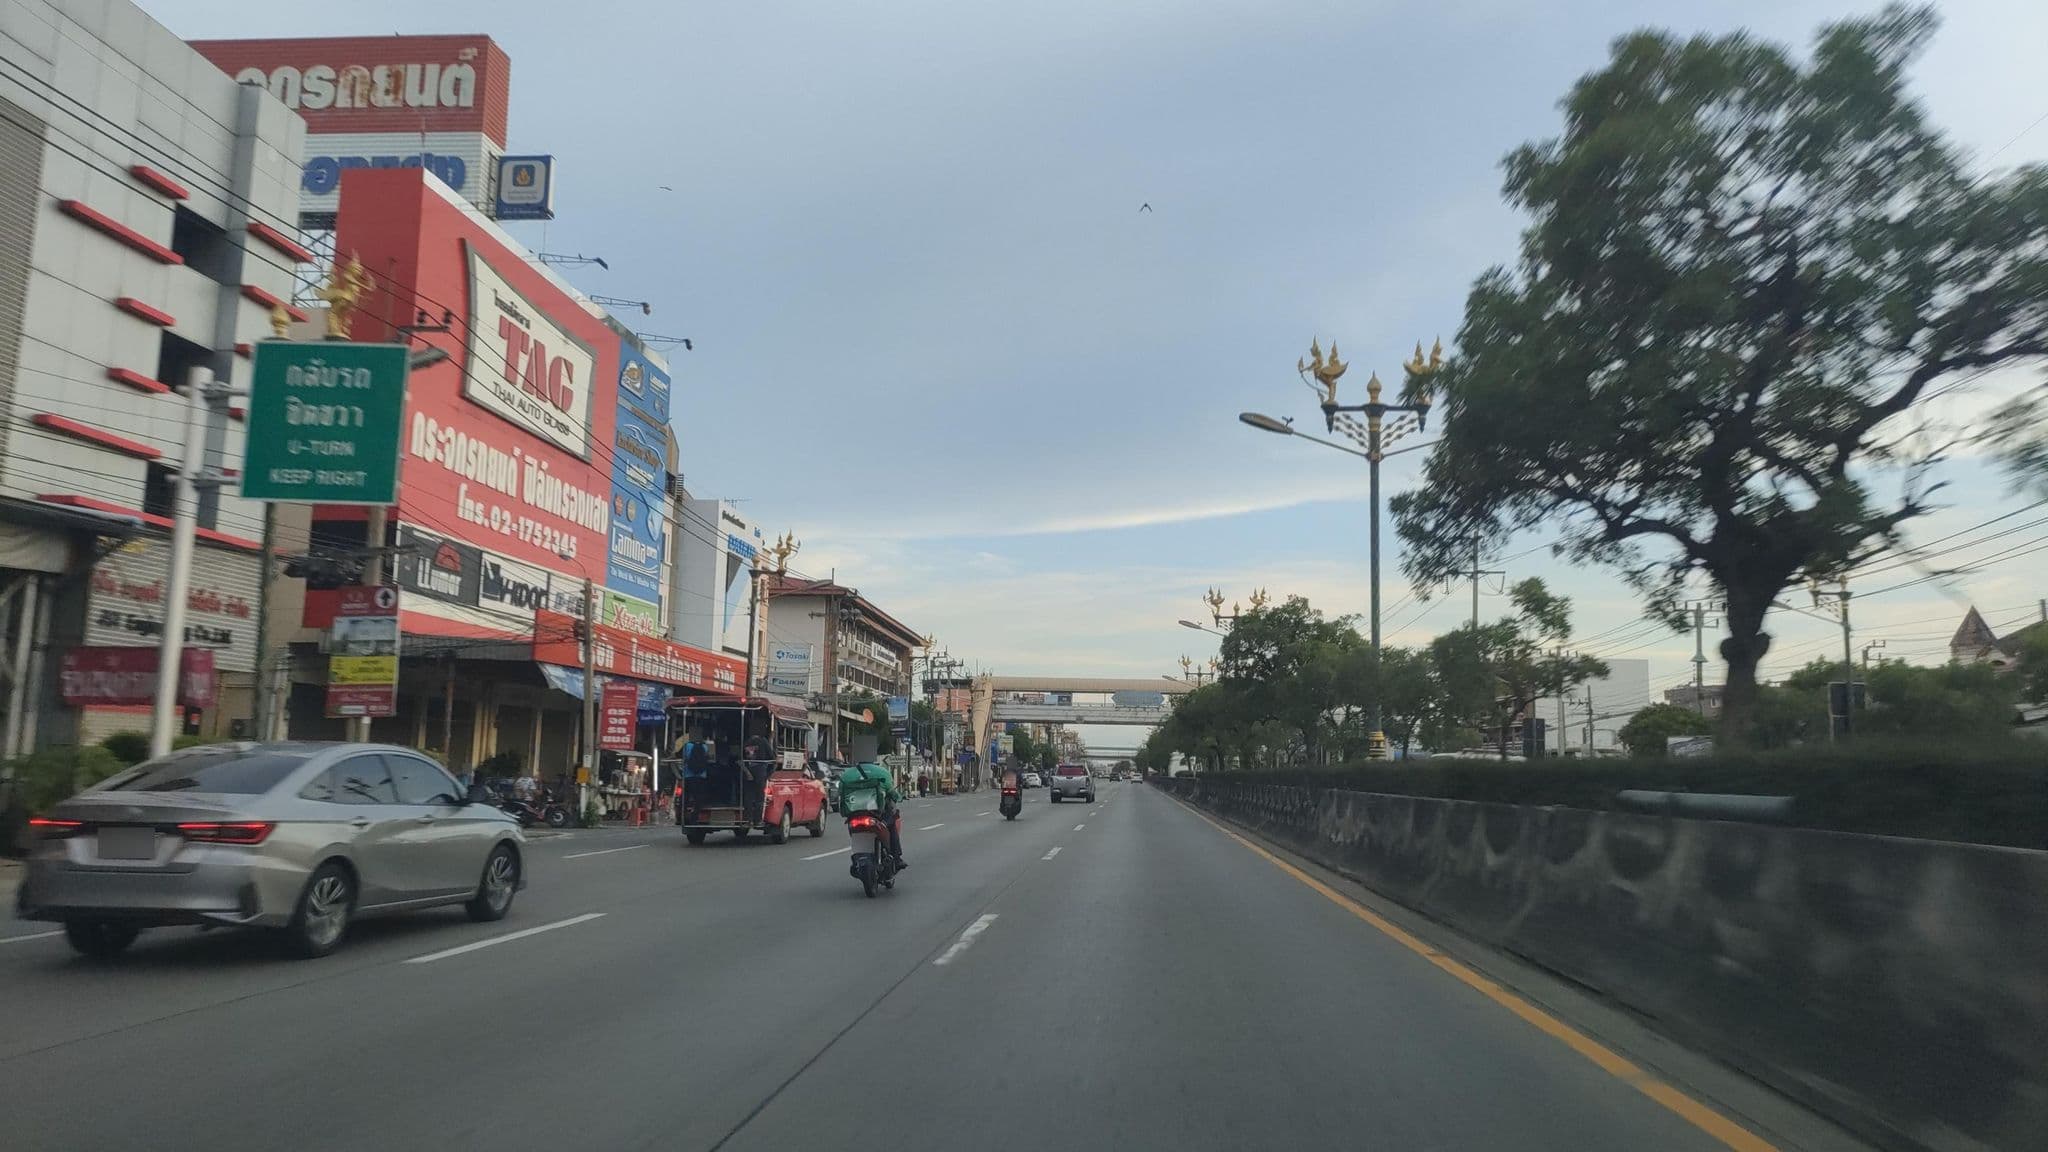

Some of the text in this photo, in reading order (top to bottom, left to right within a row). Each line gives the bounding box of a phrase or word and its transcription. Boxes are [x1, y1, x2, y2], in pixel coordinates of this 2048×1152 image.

[286, 358, 371, 389] กลับรถ
[499, 315, 574, 412] TAG
[286, 396, 364, 427] ชิดขวา
[493, 381, 570, 436] THAI AUTO GLASS
[287, 439, 354, 456] U-TURN
[410, 411, 521, 498] กระจกรถยนต์
[269, 468, 367, 487] KEEP RIGHT
[612, 527, 646, 564] Lamina
